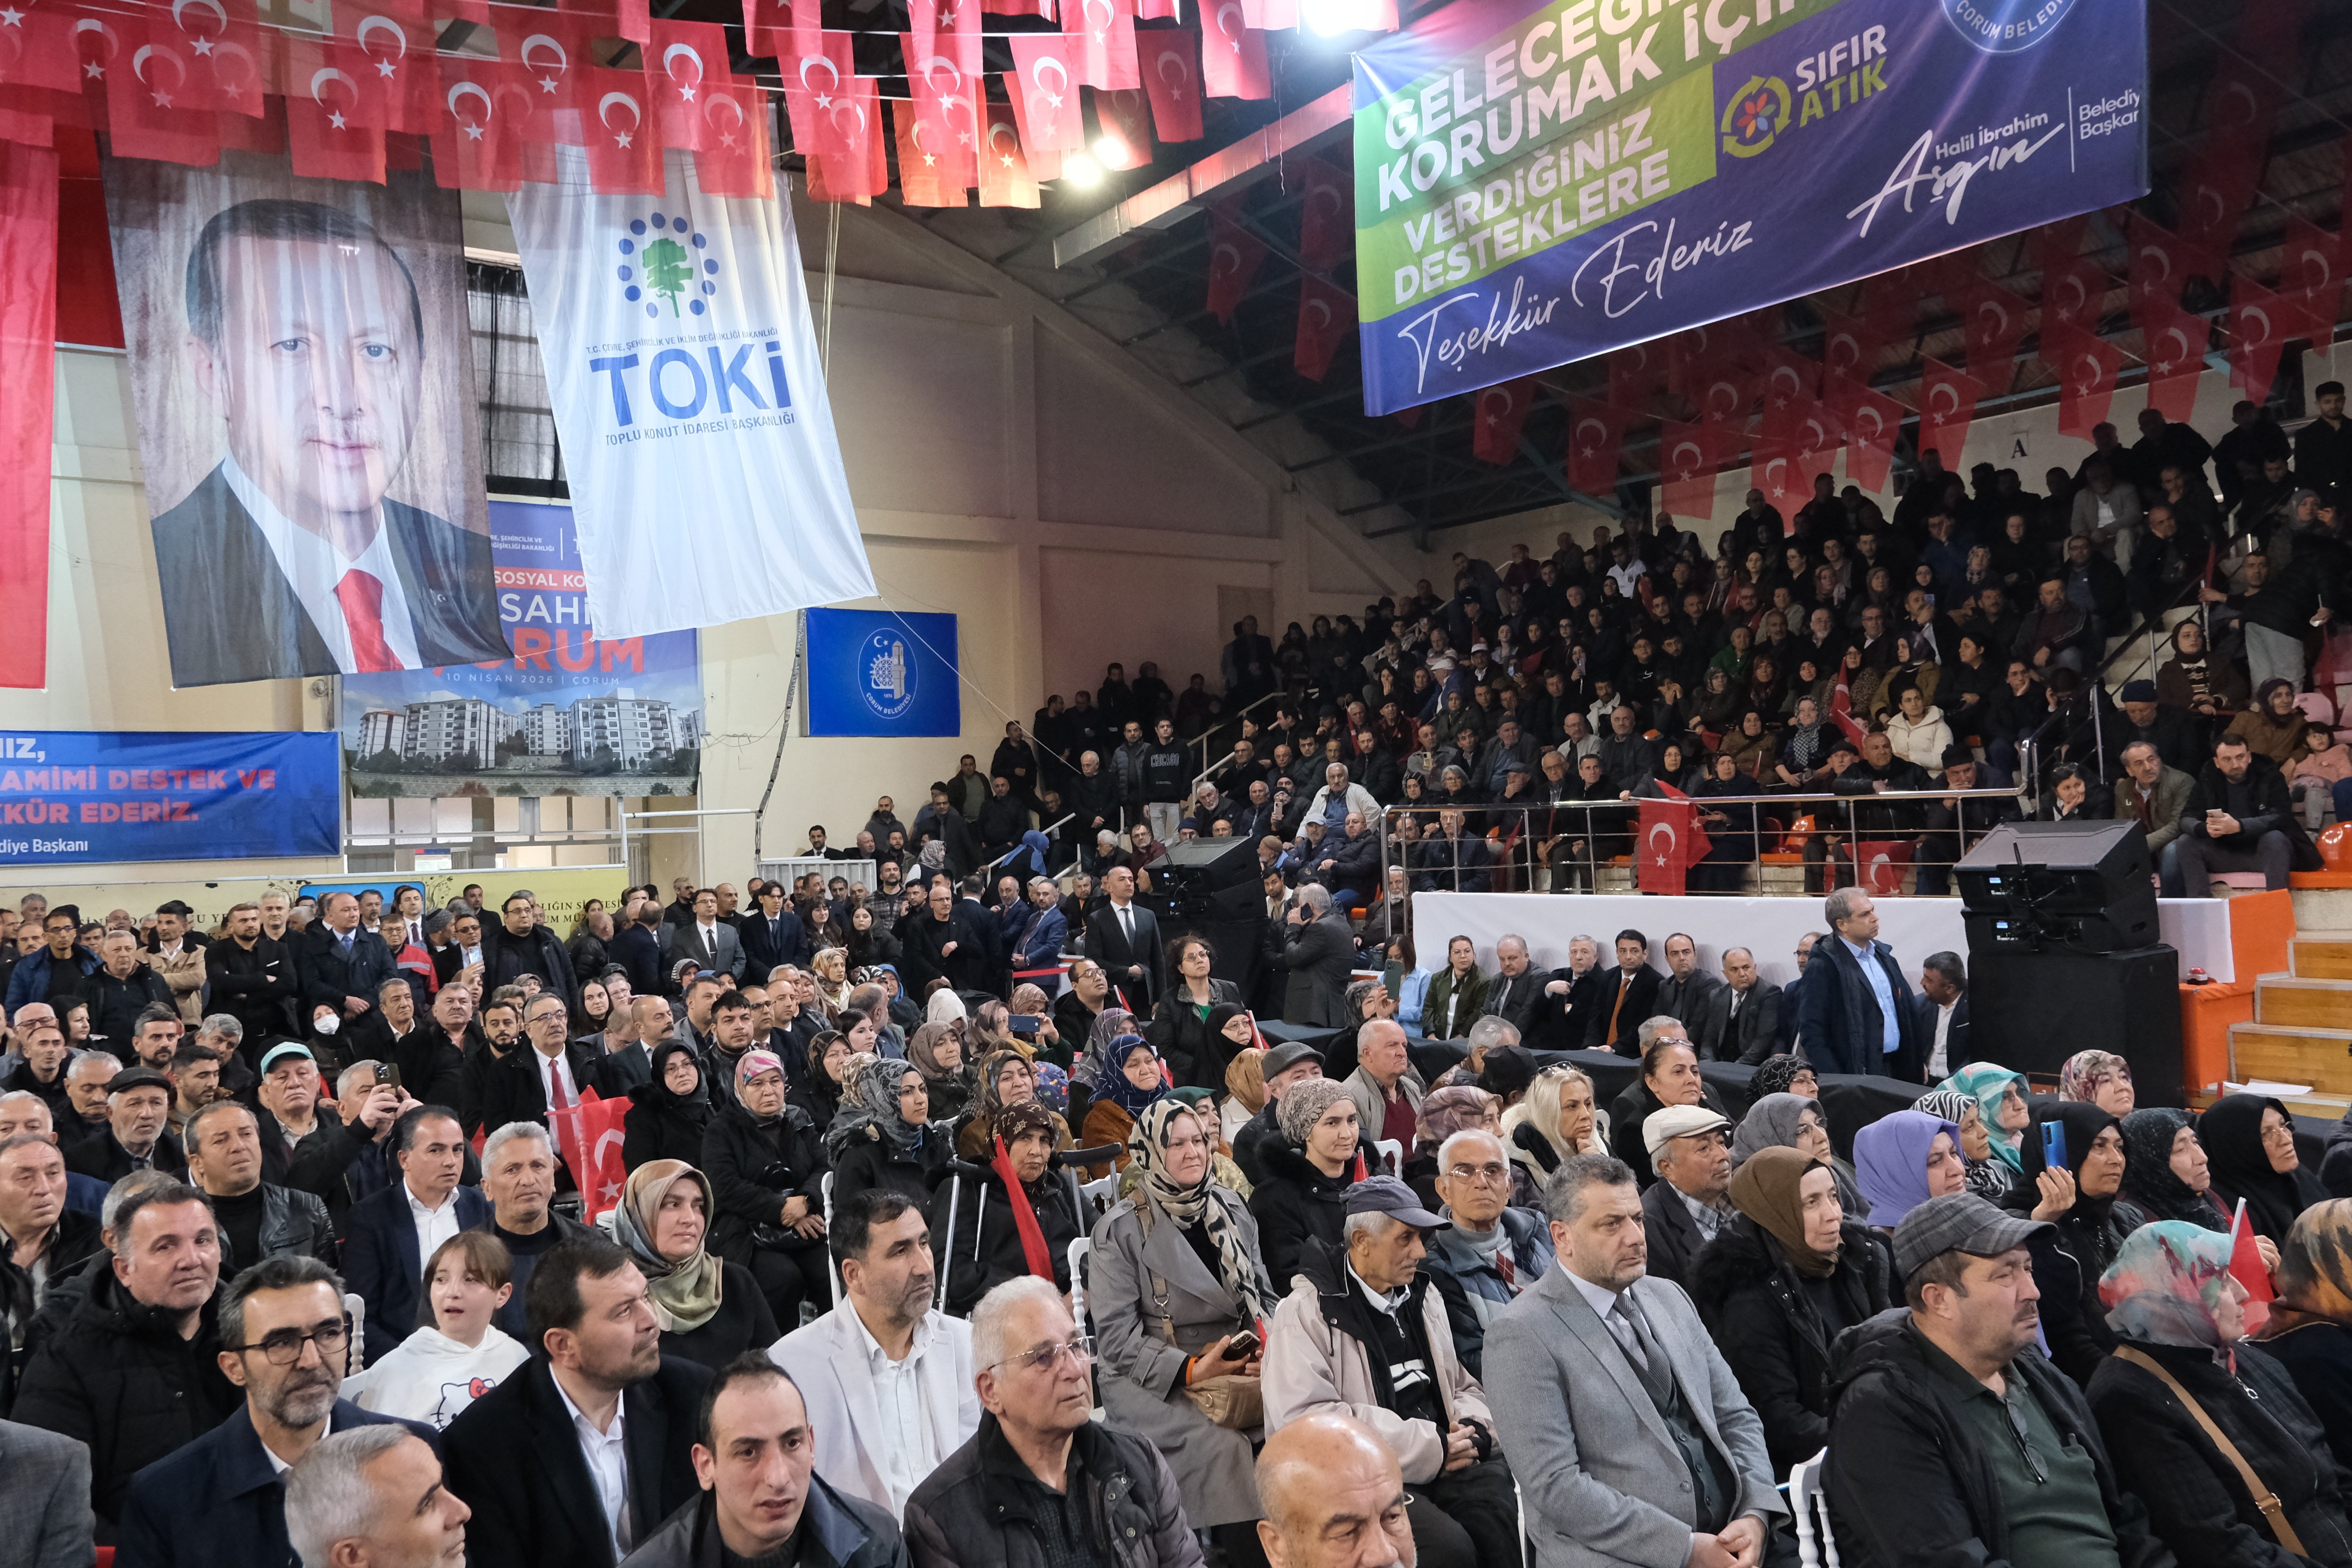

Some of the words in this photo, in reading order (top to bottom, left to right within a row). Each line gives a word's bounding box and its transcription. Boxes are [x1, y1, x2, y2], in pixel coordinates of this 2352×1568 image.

[1956, 0, 2001, 39] ÇORUM
[1796, 24, 1887, 92] SIFIR
[1799, 56, 1887, 128] ATIK
[1379, 22, 1663, 212] KORUMAK
[1935, 133, 1974, 160] Halil
[1978, 112, 2048, 147] İbrahim
[1403, 106, 1653, 253] VERDİĞİNİZ
[1395, 149, 1671, 305] DESTEKLERE
[1398, 276, 1560, 394] Teşekkür
[1572, 218, 1754, 318] Ederiz
[665, 337, 676, 345] VE
[677, 335, 697, 343] İKLİM
[606, 429, 641, 446] TOPLU
[645, 425, 679, 440] KONUT
[683, 418, 729, 435] İDARESİ
[732, 412, 795, 432] BAŞKANLIĞI
[2011, 439, 2028, 458] A
[494, 571, 558, 587] SOSYAL
[447, 673, 460, 682] 10
[470, 673, 513, 683] NİSAN
[521, 675, 553, 684] 2026
[573, 677, 619, 685] ÇORUM
[866, 693, 883, 712] ÇORUM
[883, 693, 912, 714] BELEDİYESİ
[1151, 753, 1179, 768] CHICAGO
[109, 769, 227, 790] DESTEK
[239, 769, 276, 789] VE
[81, 796, 199, 823] EDERİZ.
[33, 838, 88, 854] Başkanı
